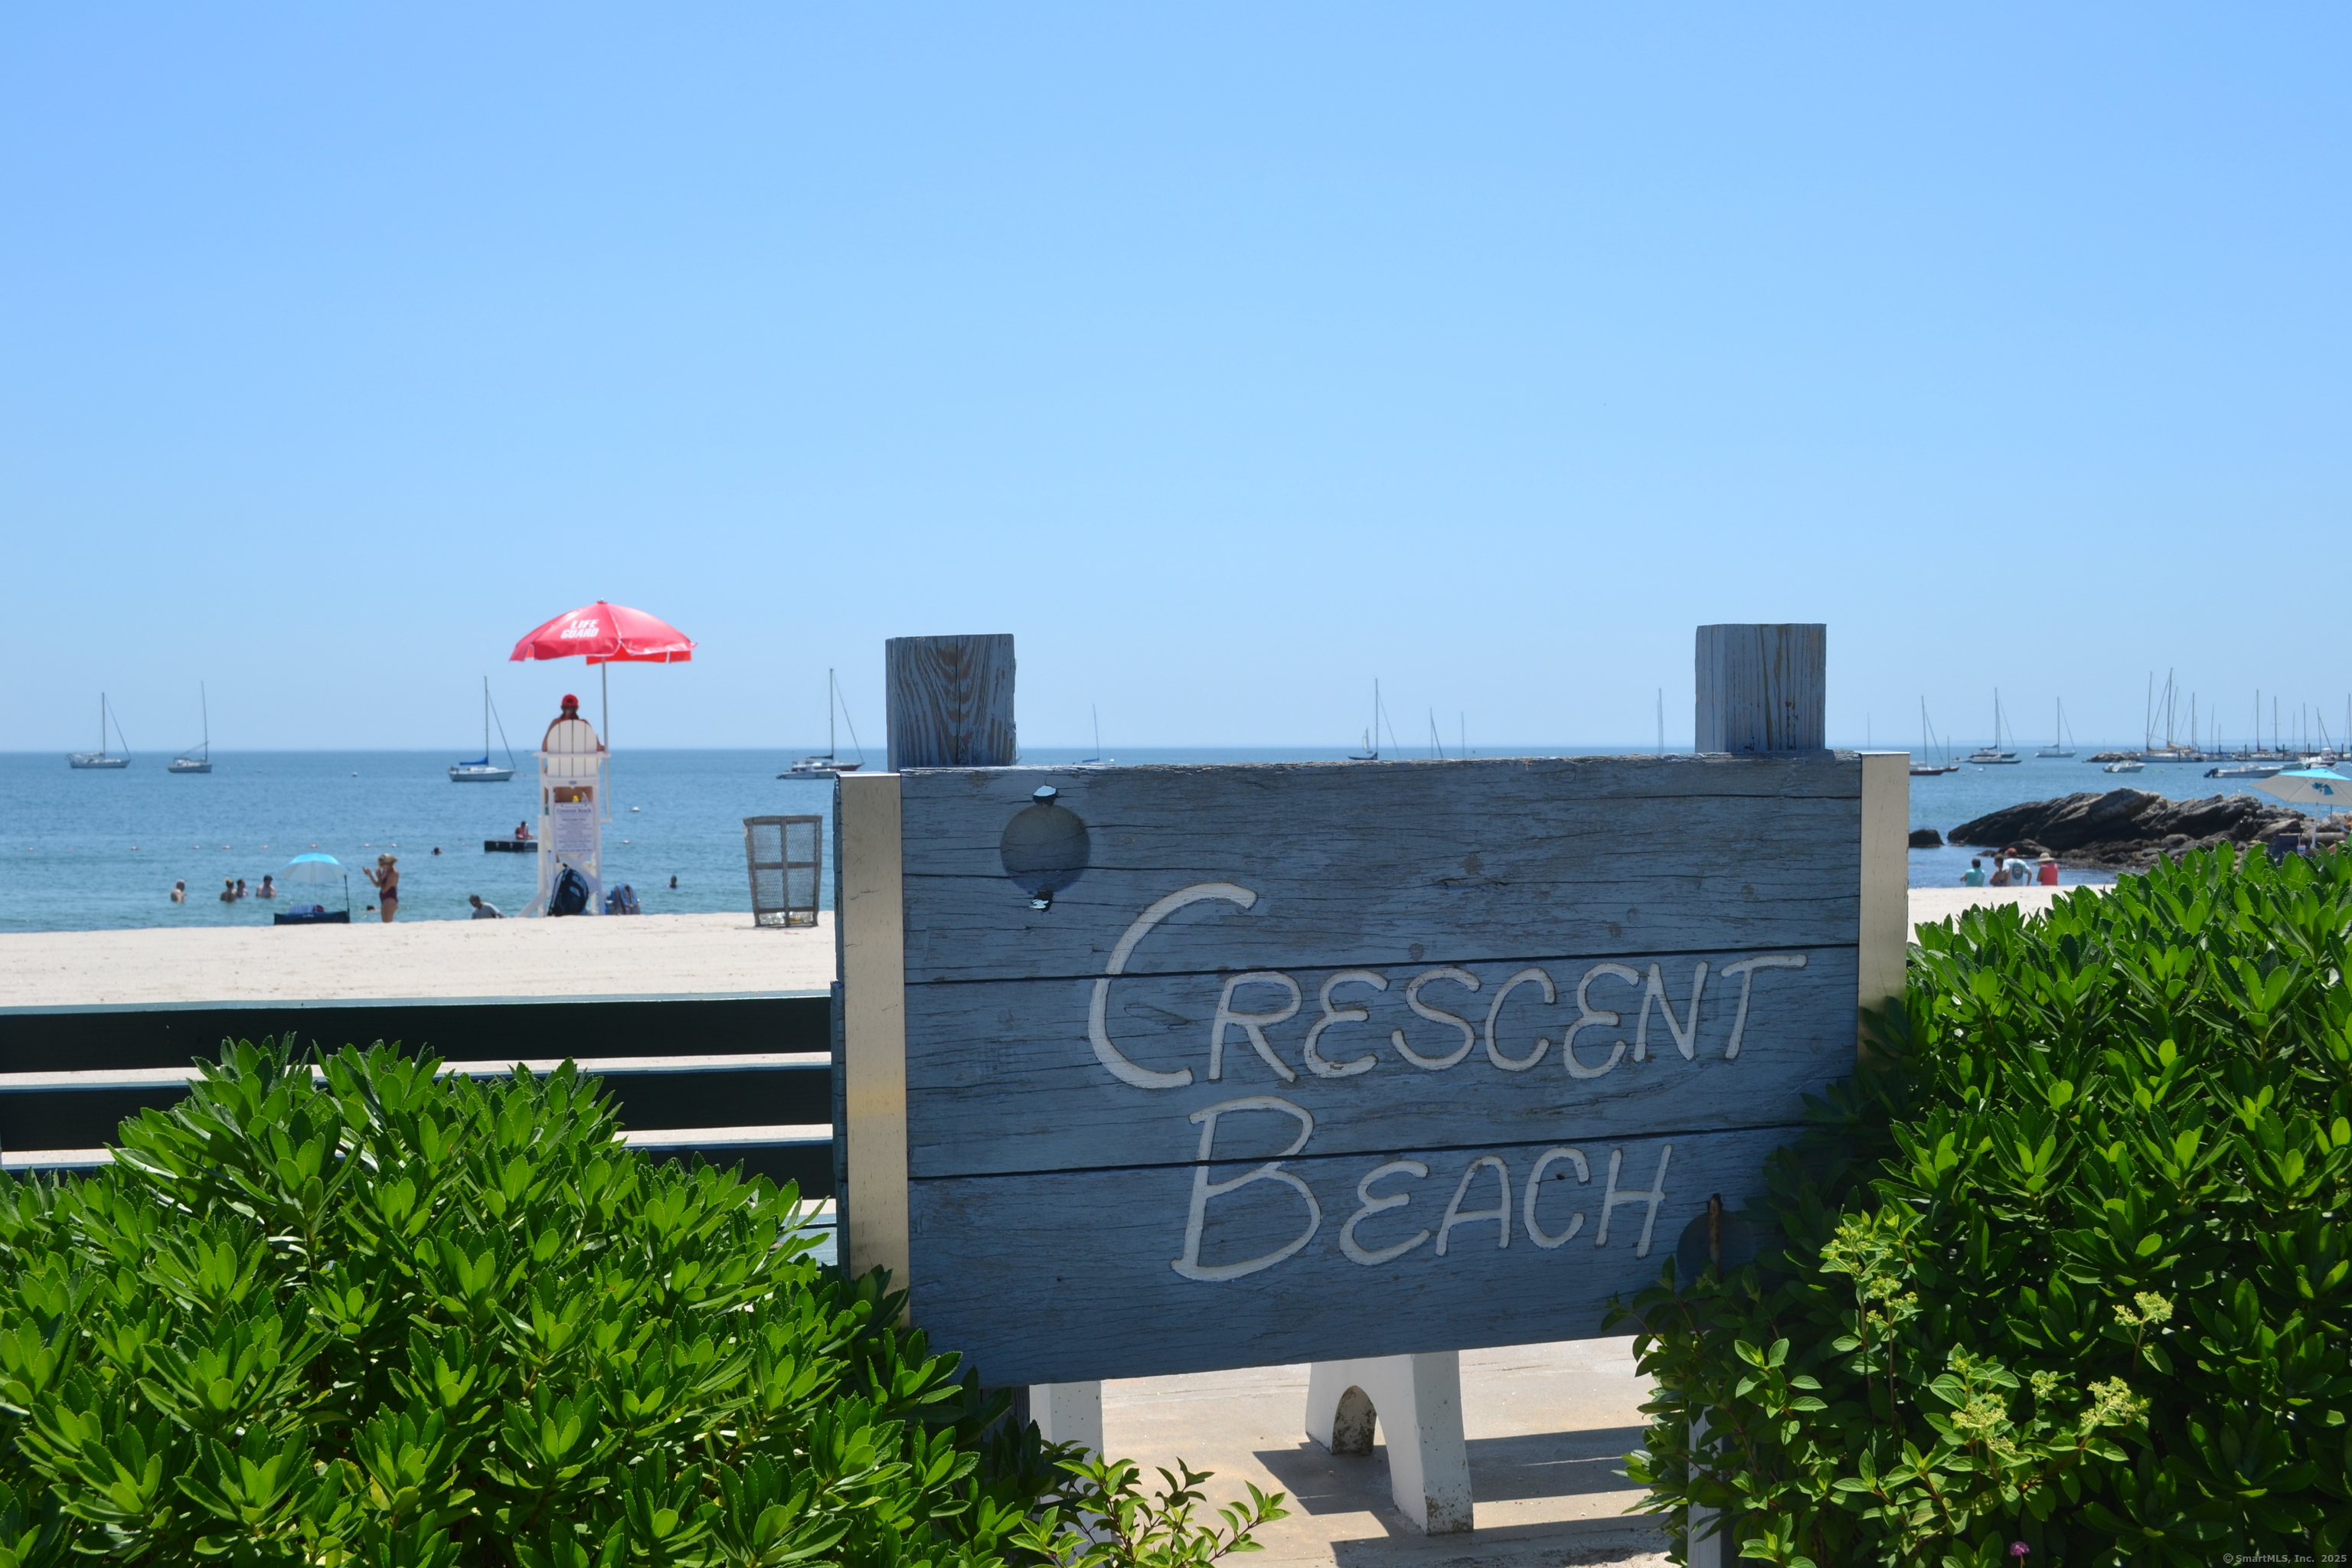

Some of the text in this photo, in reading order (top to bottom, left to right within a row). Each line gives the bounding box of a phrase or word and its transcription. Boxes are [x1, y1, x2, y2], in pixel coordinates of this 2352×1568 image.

[561, 628, 599, 639] GUARD
[571, 619, 599, 629] LIFE
[1087, 882, 1807, 1089] CRESCENT
[1171, 1095, 1672, 1282] BEACH
